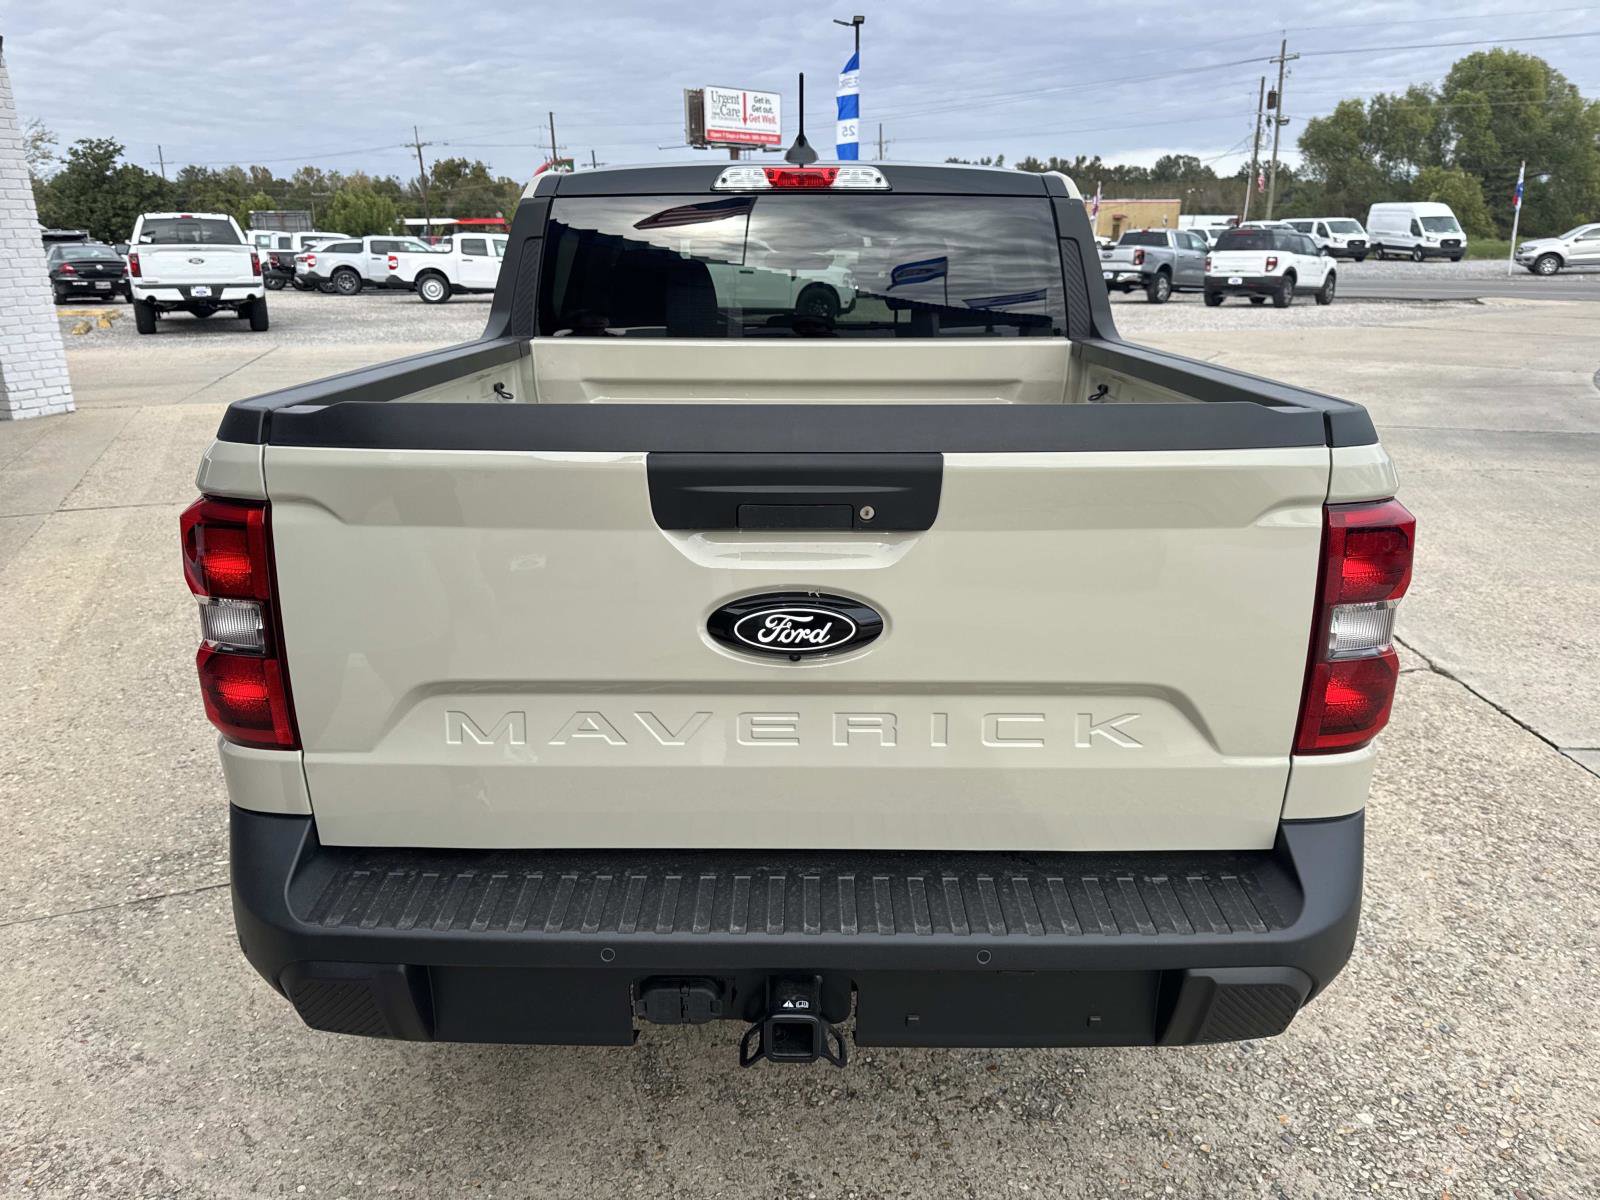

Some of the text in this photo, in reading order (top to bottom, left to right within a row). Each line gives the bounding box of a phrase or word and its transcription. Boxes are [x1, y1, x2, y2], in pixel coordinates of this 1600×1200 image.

[711, 90, 740, 106] Urgent
[753, 96, 764, 104] Get
[719, 104, 741, 118] Care
[751, 104, 762, 113] Get
[748, 113, 760, 123] Get
[757, 614, 832, 643] Ford
[445, 710, 1144, 748] MAVERICK
